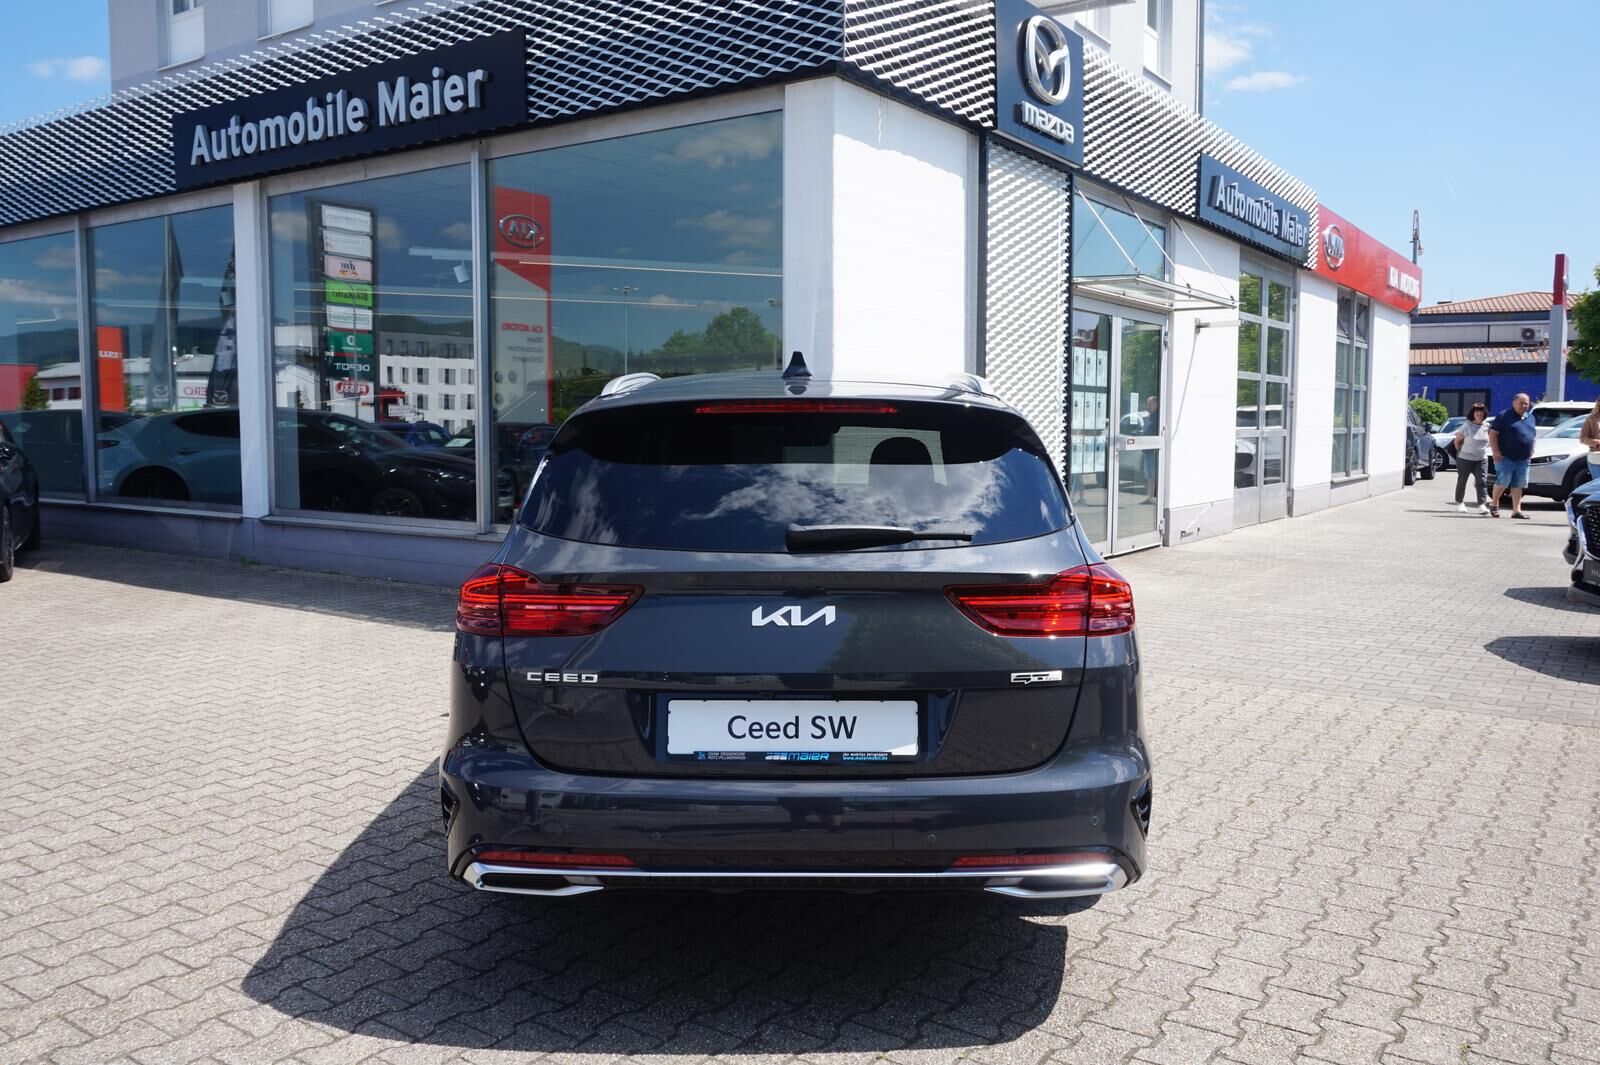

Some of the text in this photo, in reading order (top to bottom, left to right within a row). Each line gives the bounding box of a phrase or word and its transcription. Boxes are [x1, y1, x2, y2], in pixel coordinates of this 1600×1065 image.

[191, 66, 488, 165] Automobile Maier
[1215, 174, 1308, 247] Automobile Maier
[527, 672, 598, 683] CEED
[727, 715, 858, 740] Ceed SW
